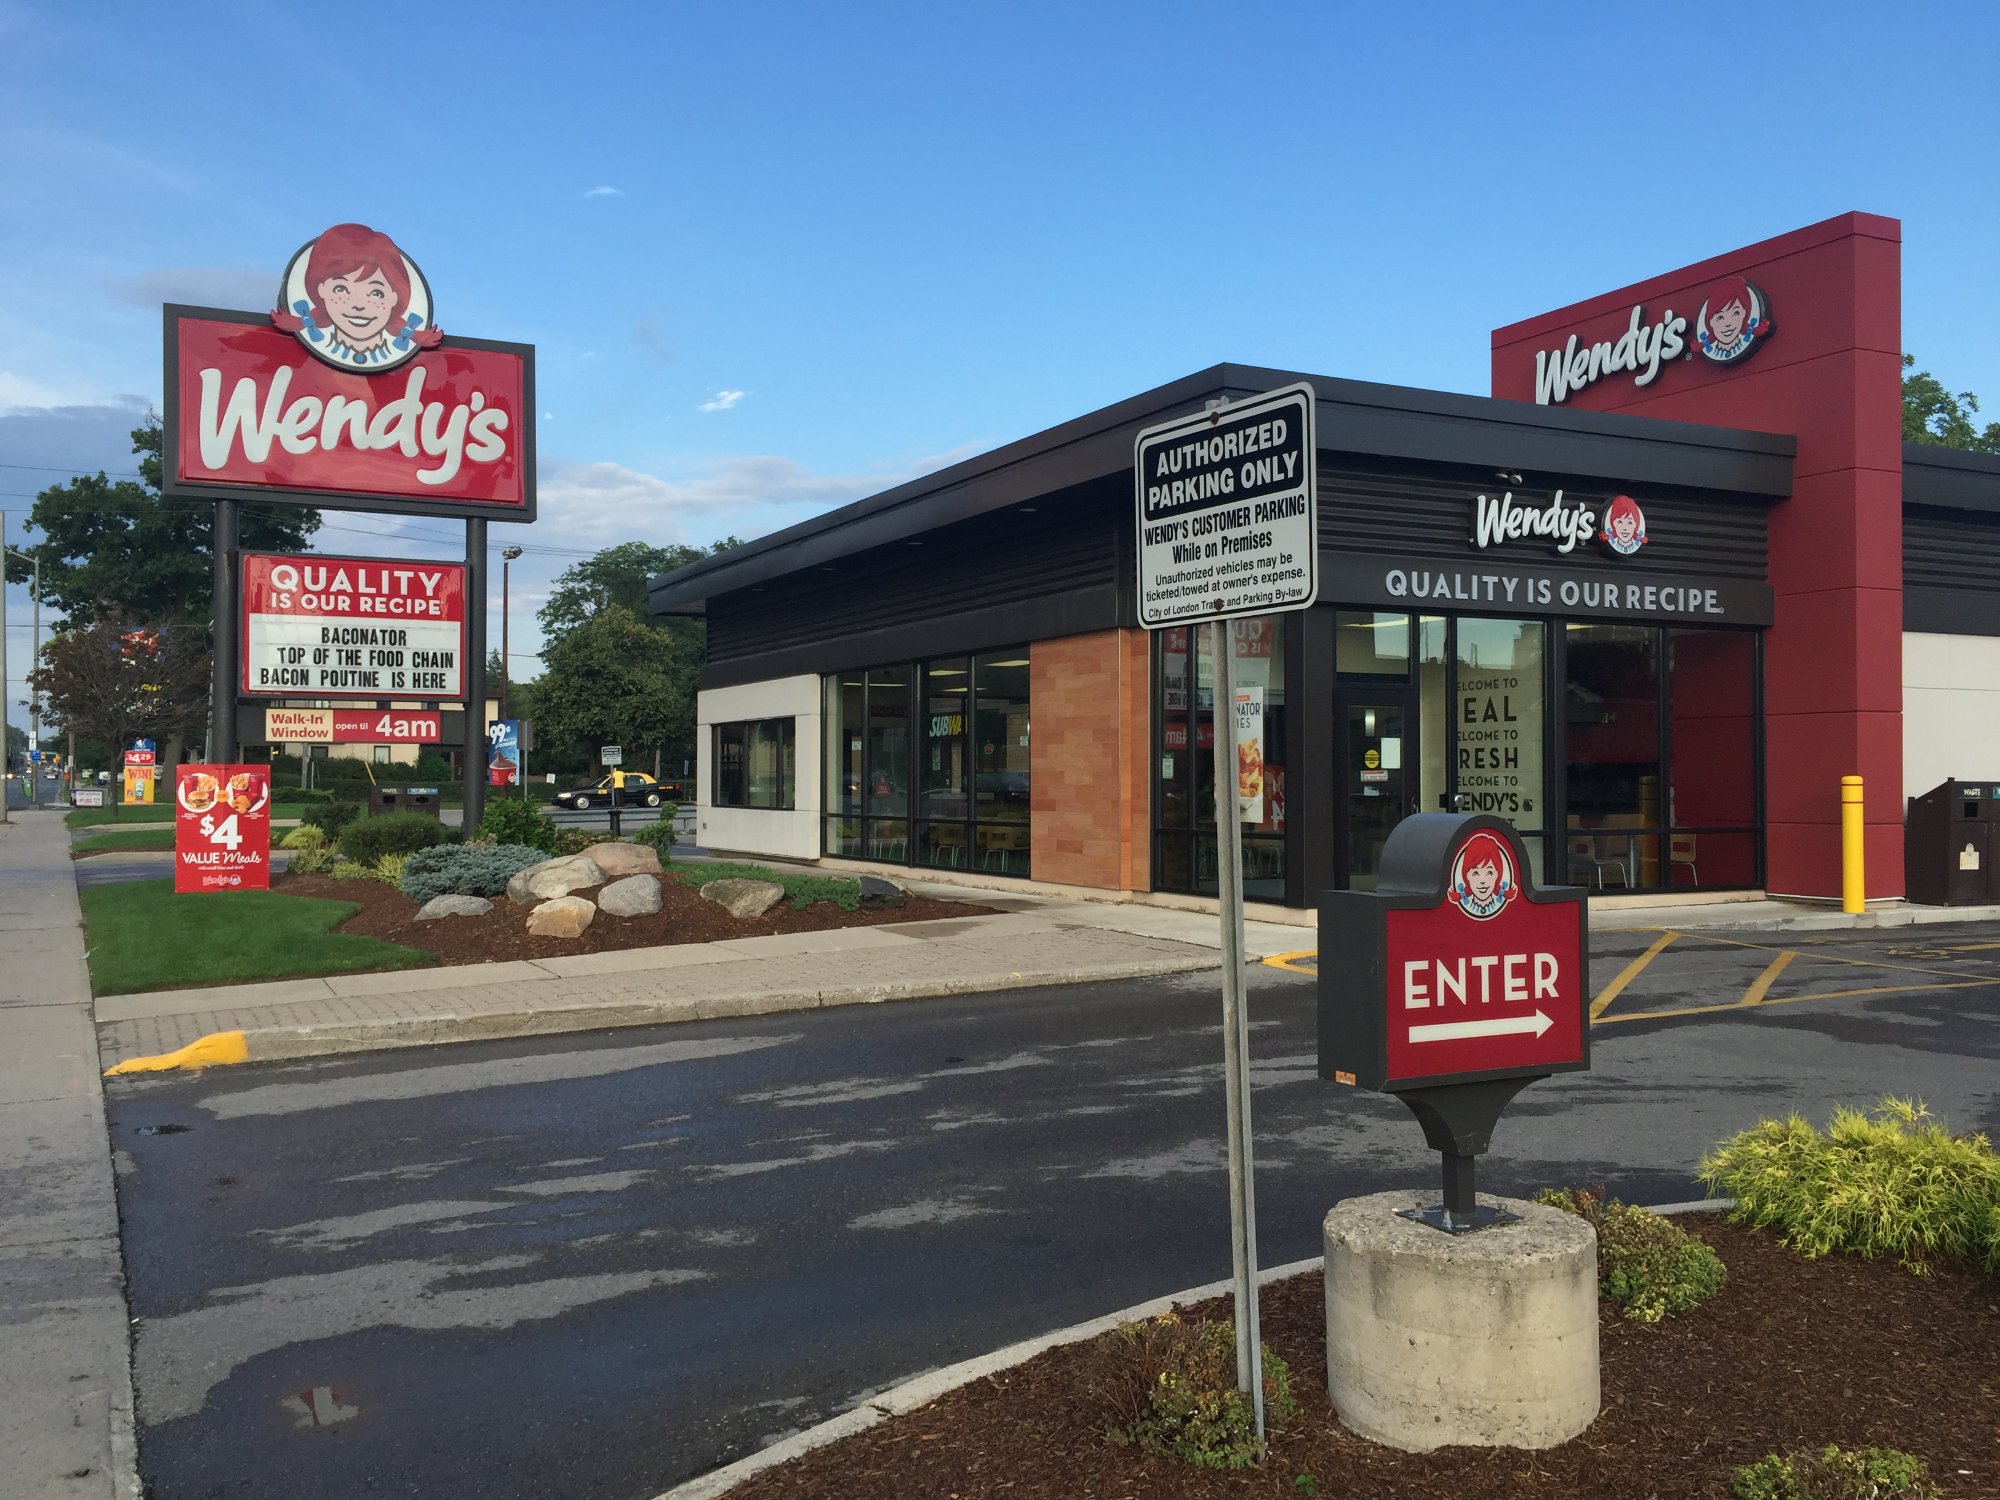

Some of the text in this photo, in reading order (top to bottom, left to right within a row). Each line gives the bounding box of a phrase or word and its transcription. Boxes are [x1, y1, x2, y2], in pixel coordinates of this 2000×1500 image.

[1535, 305, 1687, 406] Wendy's
[199, 365, 508, 485] Wendy's
[1156, 419, 1287, 478] AUTHORIZED
[1149, 450, 1298, 511] PARKING ONLY
[1145, 493, 1305, 547] WENDY'S CUSTOMER PARKING
[1476, 489, 1594, 553] Wendy's
[1172, 530, 1273, 565] While on Premises
[271, 564, 442, 597] QUALITY
[1146, 567, 1307, 603] ticketed/towed at owner's expense.
[1155, 552, 1293, 587] Unauthorized vehicles may be
[271, 592, 441, 616] IS OUR RECIPE
[1148, 608, 1162, 619] City
[1163, 606, 1171, 616] of
[1172, 602, 1200, 614] London
[1227, 597, 1241, 607] and
[1242, 592, 1273, 605] Parking
[1275, 586, 1303, 600] By-law
[1385, 569, 1519, 602] QUALITY
[1527, 578, 1551, 604] IS
[1560, 580, 1619, 608] OUR
[321, 627, 407, 646] BACONATOR
[277, 647, 454, 669] TOP OF THE FOOD CHAIN
[260, 668, 446, 689] BACON POUTINE IS HERE
[1457, 677, 1518, 691] ELCOME TO
[271, 713, 323, 725] Walk-In
[271, 728, 329, 739] Window
[335, 714, 437, 738] open til 4am
[1457, 730, 1518, 742] ELCOME TO
[1457, 776, 1518, 787] ELCOME TO
[1460, 792, 1519, 812] ENDY'S
[200, 813, 243, 850] $4
[181, 851, 262, 864] VALUE Meals
[1404, 953, 1560, 1009] ENTER
